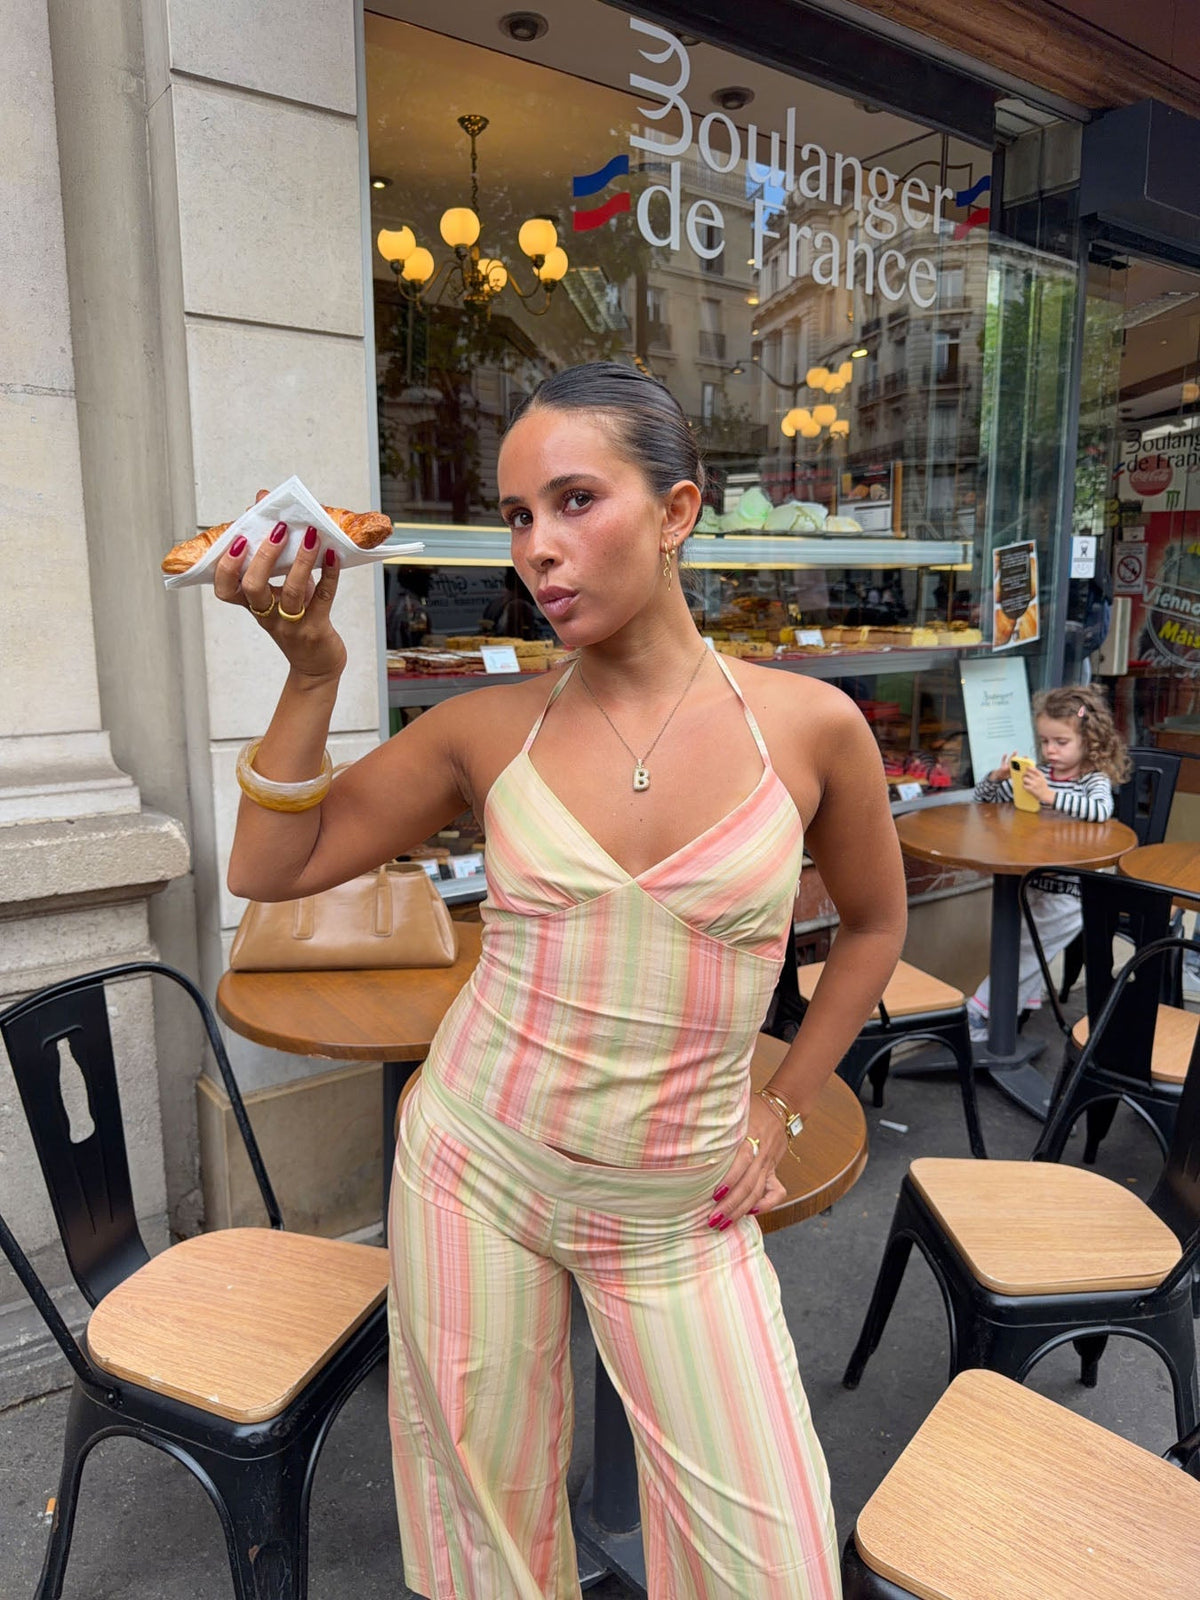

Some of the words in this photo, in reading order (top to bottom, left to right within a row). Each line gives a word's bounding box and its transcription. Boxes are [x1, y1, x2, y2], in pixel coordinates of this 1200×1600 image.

[629, 17, 955, 241] Boulanger
[637, 161, 726, 260] de
[753, 198, 938, 308] France
[1127, 454, 1149, 473] de
[1156, 450, 1200, 470] Fran
[633, 768, 651, 792] B
